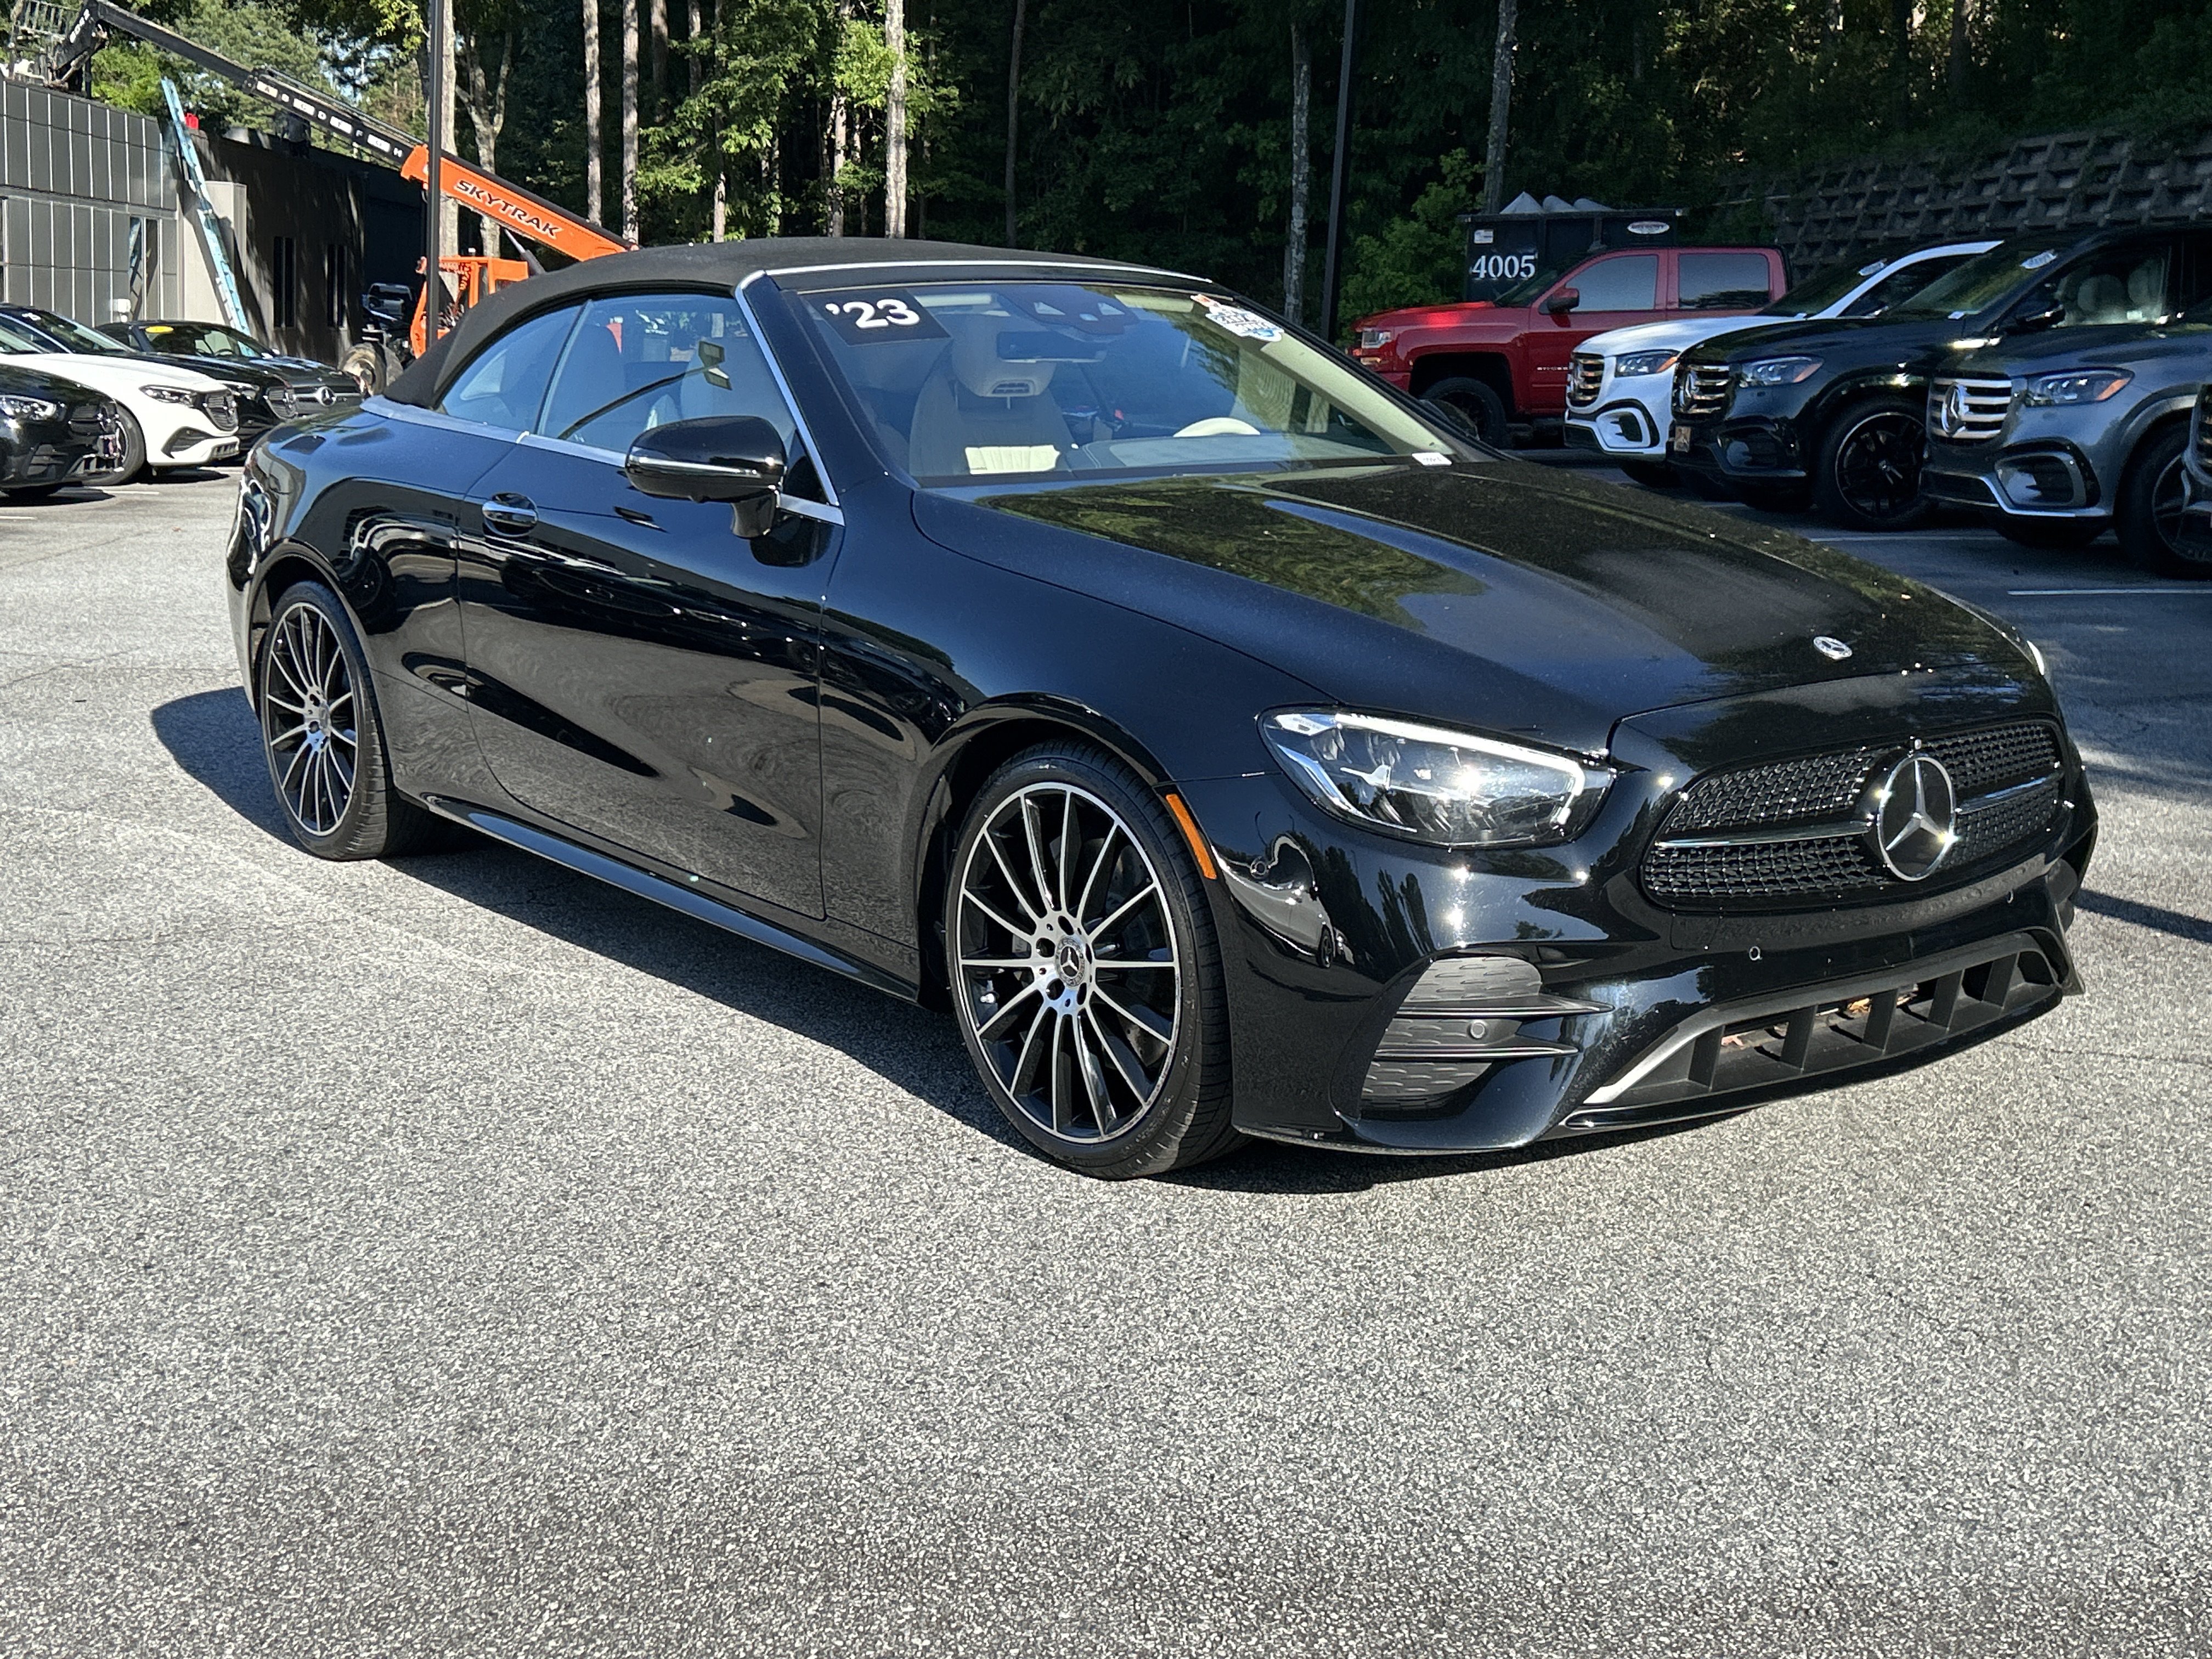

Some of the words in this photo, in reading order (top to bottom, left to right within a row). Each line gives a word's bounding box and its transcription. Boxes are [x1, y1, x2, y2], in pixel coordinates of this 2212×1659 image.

[393, 147, 403, 158] H
[455, 179, 563, 239] SKYTRAK
[1471, 255, 1536, 279] 4005
[820, 298, 921, 329] '23
